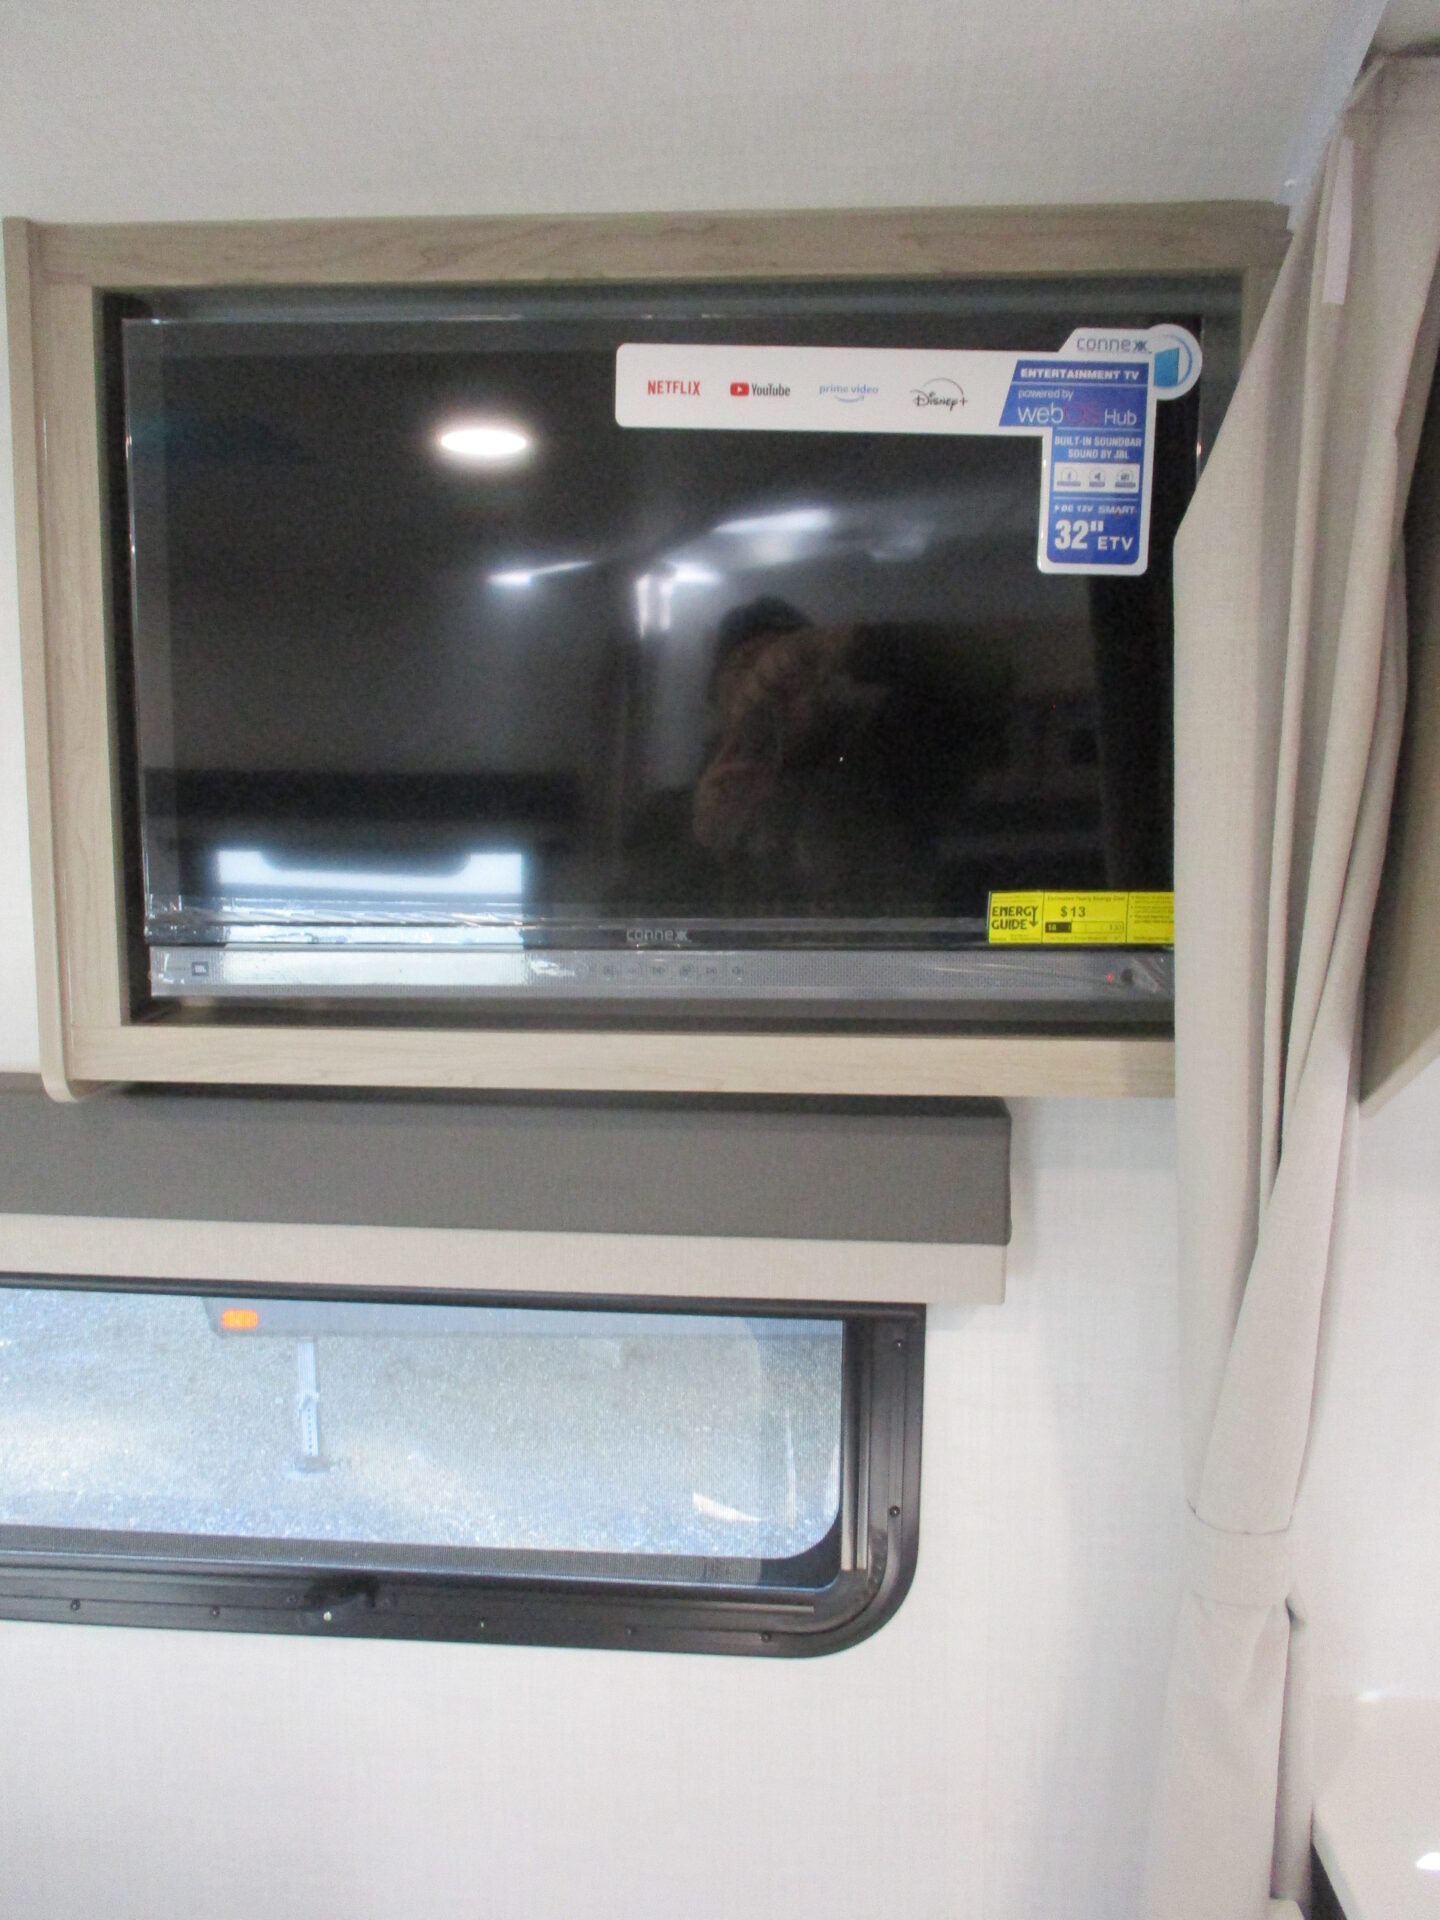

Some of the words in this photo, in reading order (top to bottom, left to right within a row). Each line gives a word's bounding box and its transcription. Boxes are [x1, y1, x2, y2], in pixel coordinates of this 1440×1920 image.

[1020, 368, 1119, 380] ENTERTAINMENT
[1124, 370, 1140, 381] TV
[647, 380, 701, 397] NETFLIX
[751, 383, 791, 398] YouTube
[819, 384, 849, 397] prime
[851, 384, 879, 396] video
[1018, 389, 1060, 400] powered
[1062, 389, 1074, 401] by
[1104, 408, 1137, 426] Hub
[1054, 436, 1092, 446] BUILT-IN
[1094, 437, 1142, 447] SOUNDBAR
[1068, 448, 1098, 458] SOUND
[1100, 449, 1112, 458] BY
[1076, 504, 1094, 513] 12V
[1098, 506, 1137, 514] SMART
[1097, 536, 1134, 550] ETV
[992, 905, 1039, 917] ENERGY
[1060, 905, 1086, 918] $13
[991, 919, 1028, 930] GUIDE
